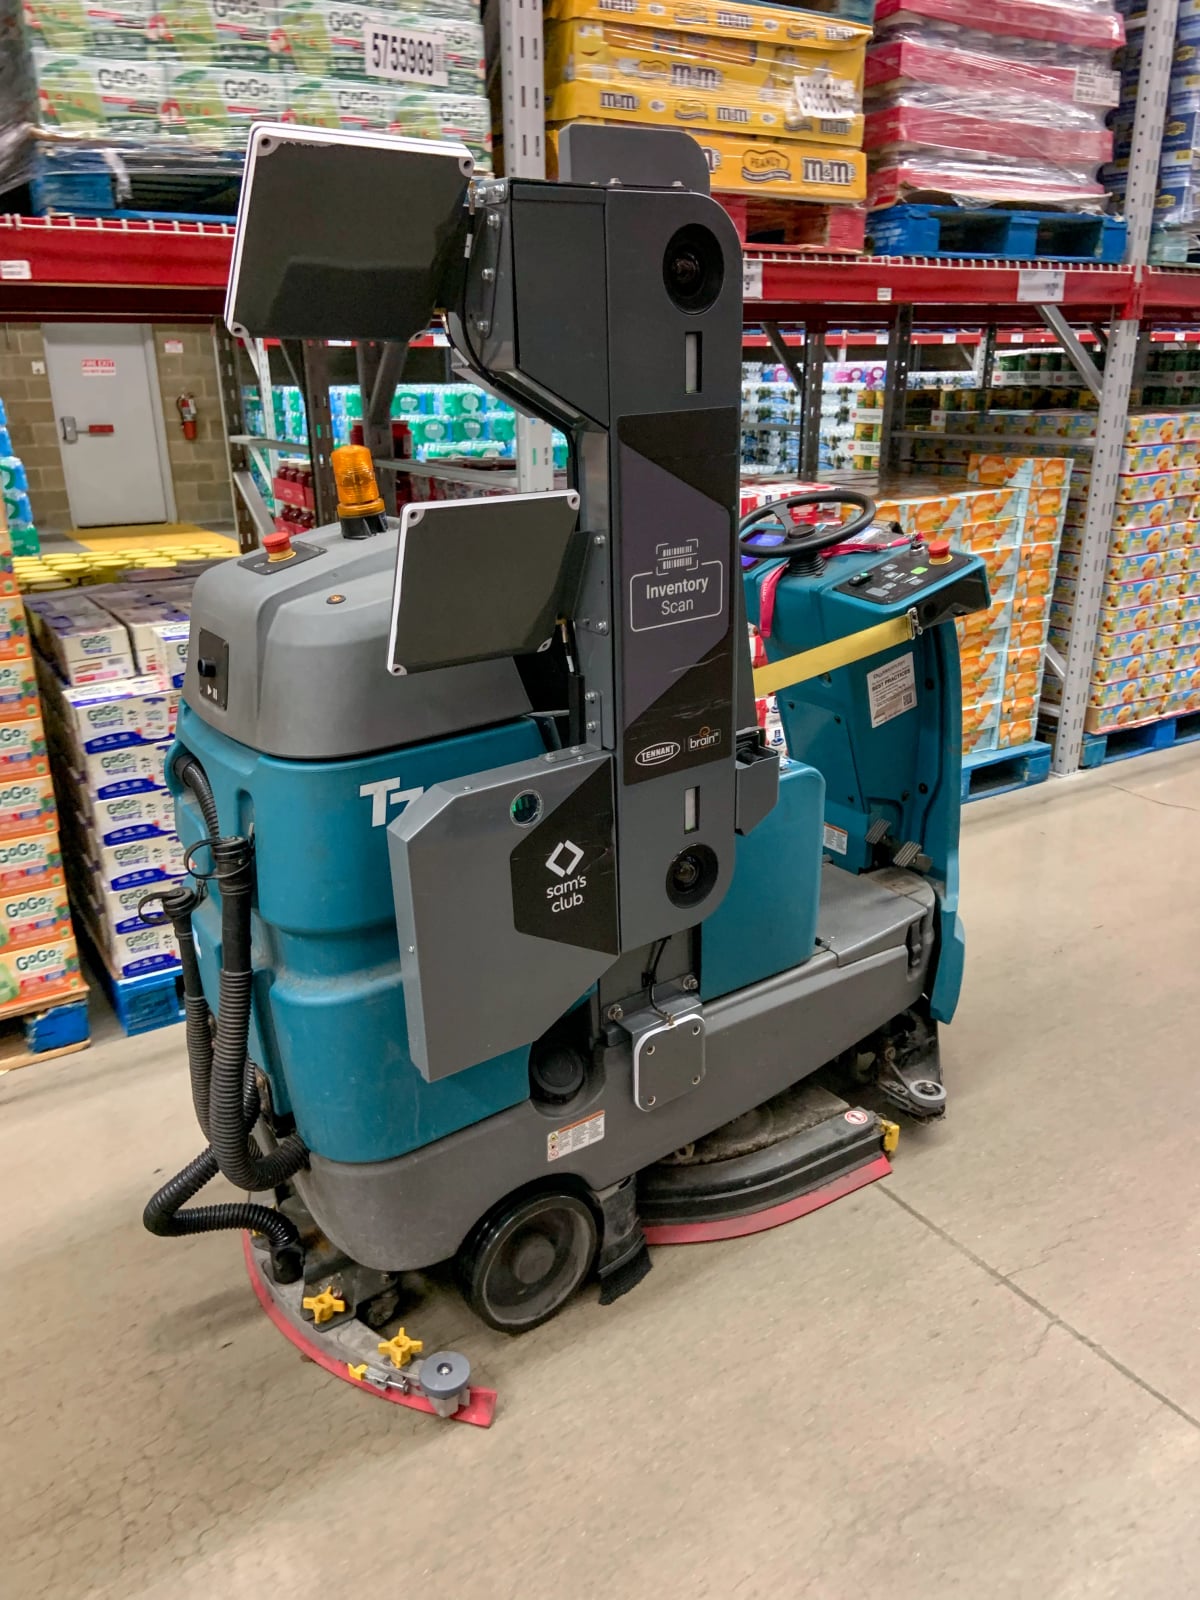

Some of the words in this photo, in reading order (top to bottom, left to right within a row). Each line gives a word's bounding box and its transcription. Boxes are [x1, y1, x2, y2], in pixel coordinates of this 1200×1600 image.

[372, 32, 434, 77] 5755989
[98, 68, 149, 90] GoGo
[224, 78, 270, 99] GoGo
[646, 577, 709, 600] Inventory
[661, 599, 694, 616] Scan
[87, 706, 120, 721] GoGo
[101, 752, 132, 769] GoGo
[641, 744, 675, 763] TENNANT
[107, 799, 138, 815] GoGo
[114, 845, 144, 861] GoGo
[119, 888, 149, 905] GoGo
[546, 875, 587, 899] sam's
[6, 896, 47, 918] GoGo
[551, 892, 583, 913] club
[126, 931, 156, 948] GoGo
[16, 949, 57, 971] GoGo
